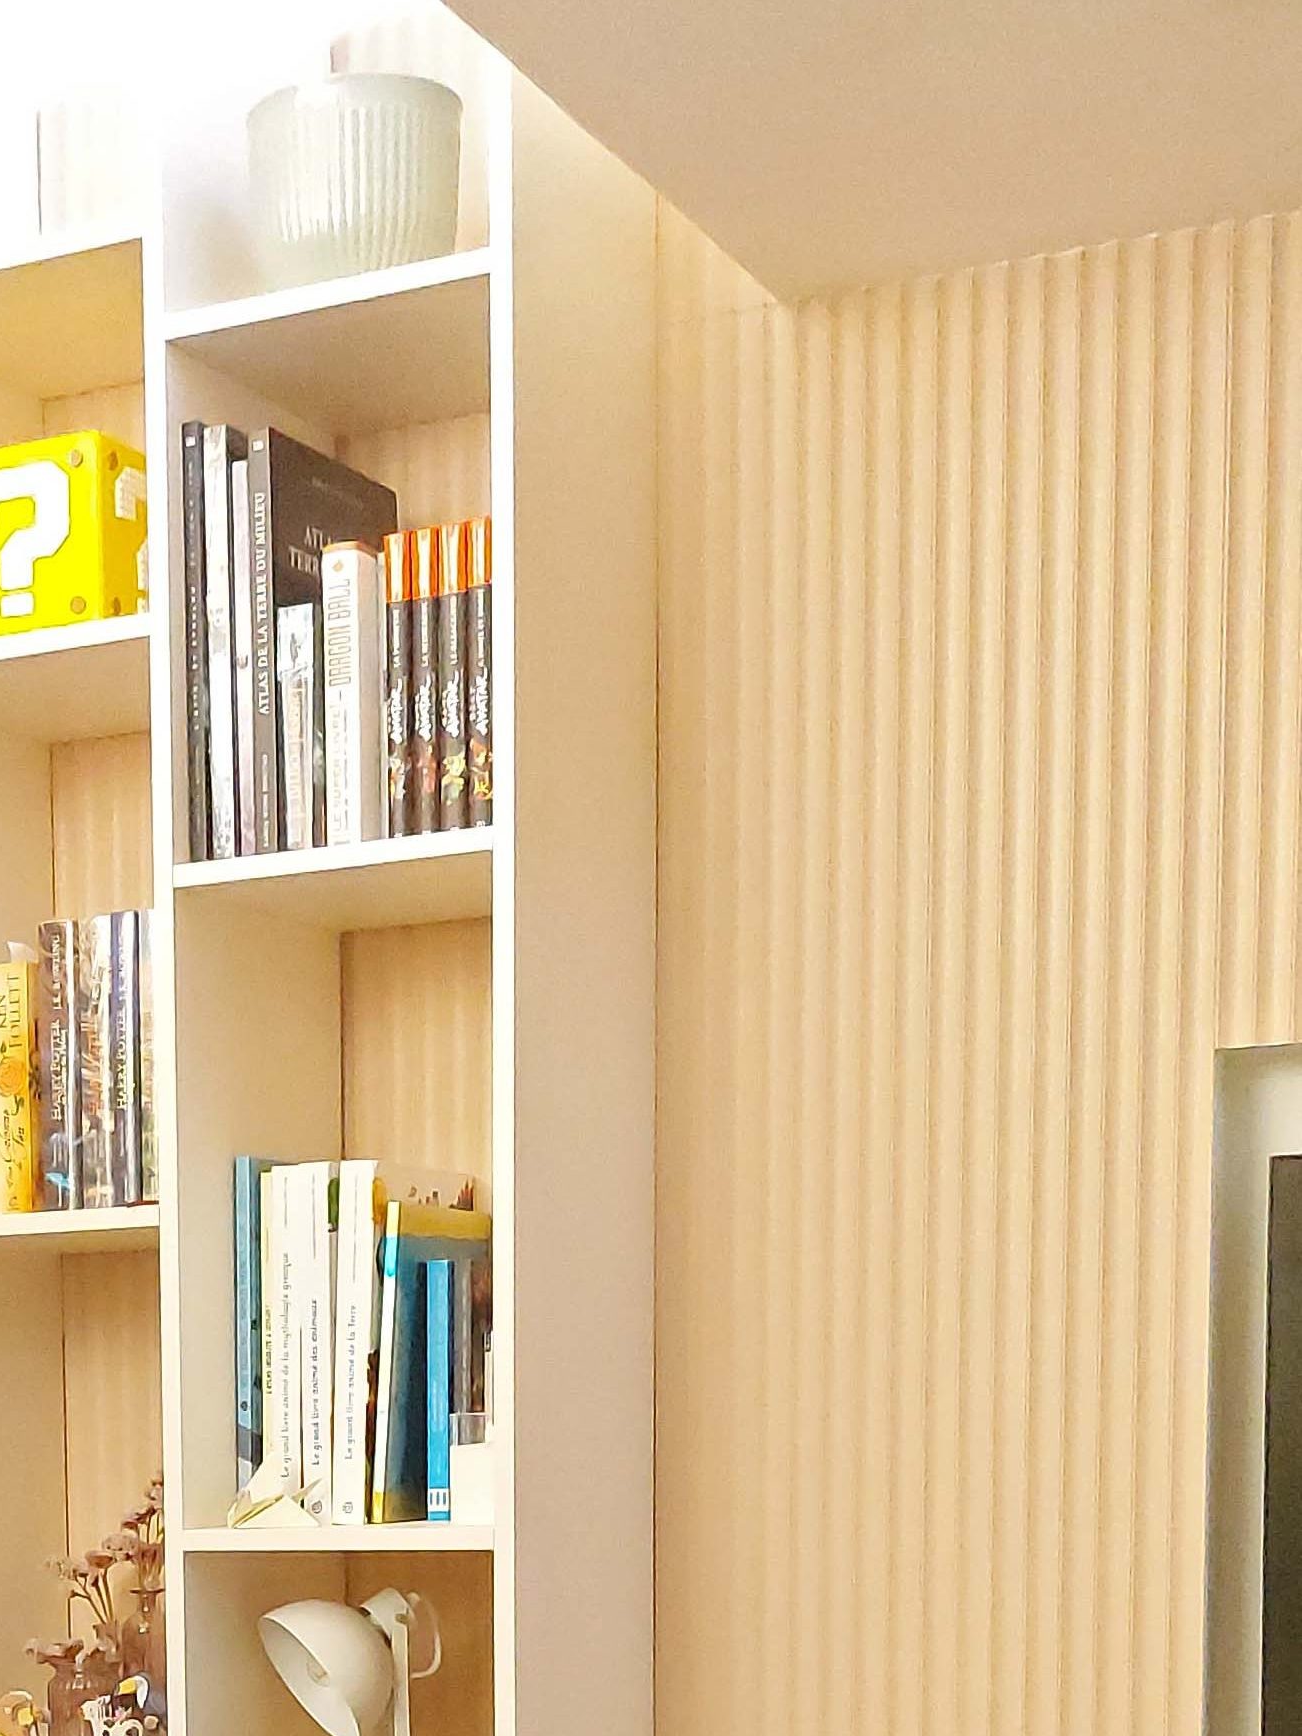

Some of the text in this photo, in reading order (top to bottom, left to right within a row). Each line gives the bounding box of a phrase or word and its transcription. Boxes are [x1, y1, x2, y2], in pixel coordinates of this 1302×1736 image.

[254, 492, 269, 715] ATLAS DE LA TERRE DU MILIEU
[328, 578, 351, 687] DRAGON BALL
[7, 973, 22, 1048] FOLLETT
[115, 1007, 127, 1060] POTTER
[50, 1019, 60, 1071] POTTER
[345, 1331, 356, 1341] la
[280, 1351, 289, 1361] la
[310, 1345, 318, 1362] des
[346, 1344, 355, 1356] de
[280, 1365, 289, 1376] de
[311, 1421, 323, 1451] grand
[281, 1435, 292, 1463] grand
[344, 1447, 353, 1460] Le
[311, 1454, 320, 1465] Le
[280, 1466, 289, 1478] Le
